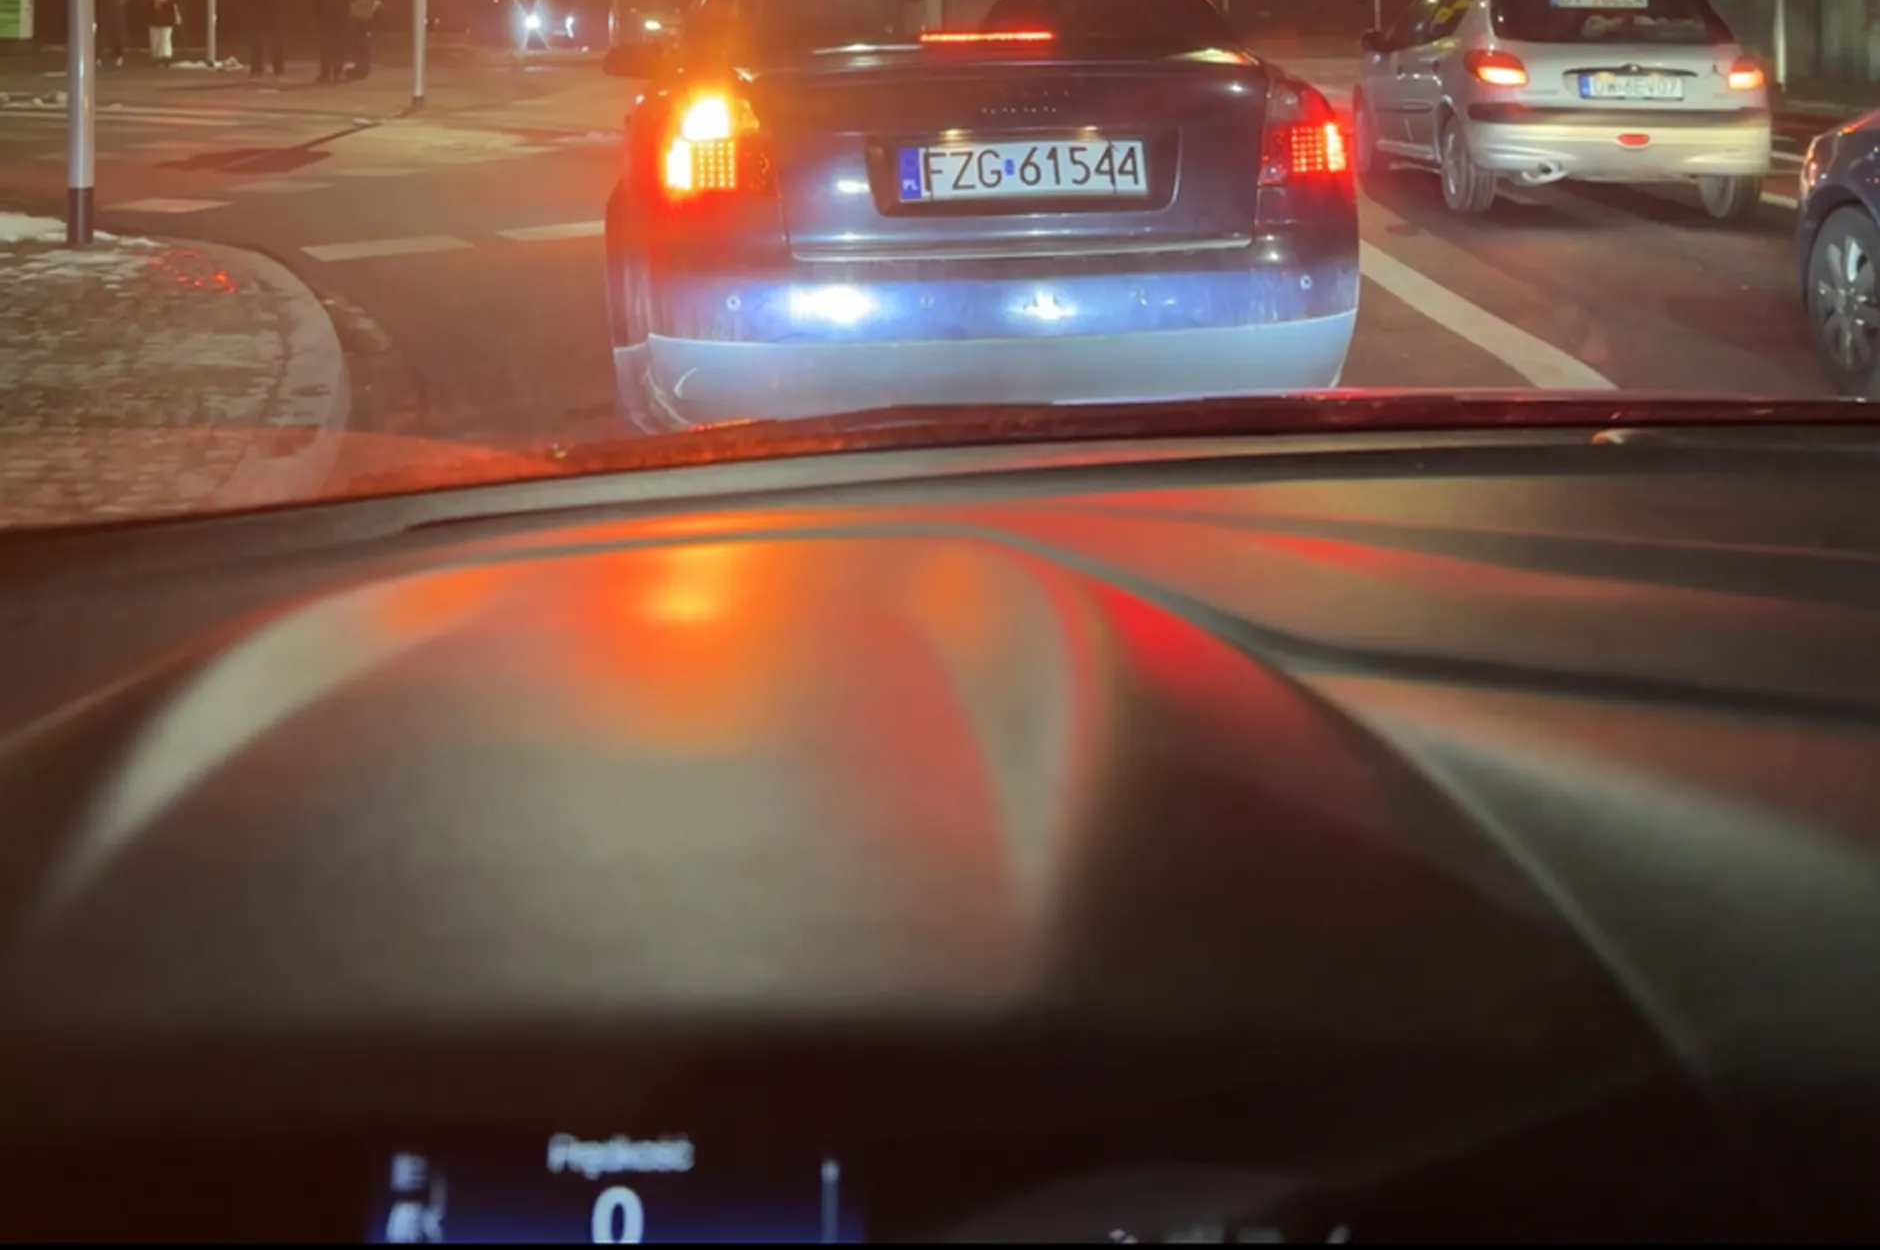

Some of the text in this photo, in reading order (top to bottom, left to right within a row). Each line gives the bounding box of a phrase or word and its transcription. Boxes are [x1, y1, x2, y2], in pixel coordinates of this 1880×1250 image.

[902, 178, 918, 191] PL
[923, 146, 1140, 192] FZG 61544
[592, 1185, 645, 1244] 0
